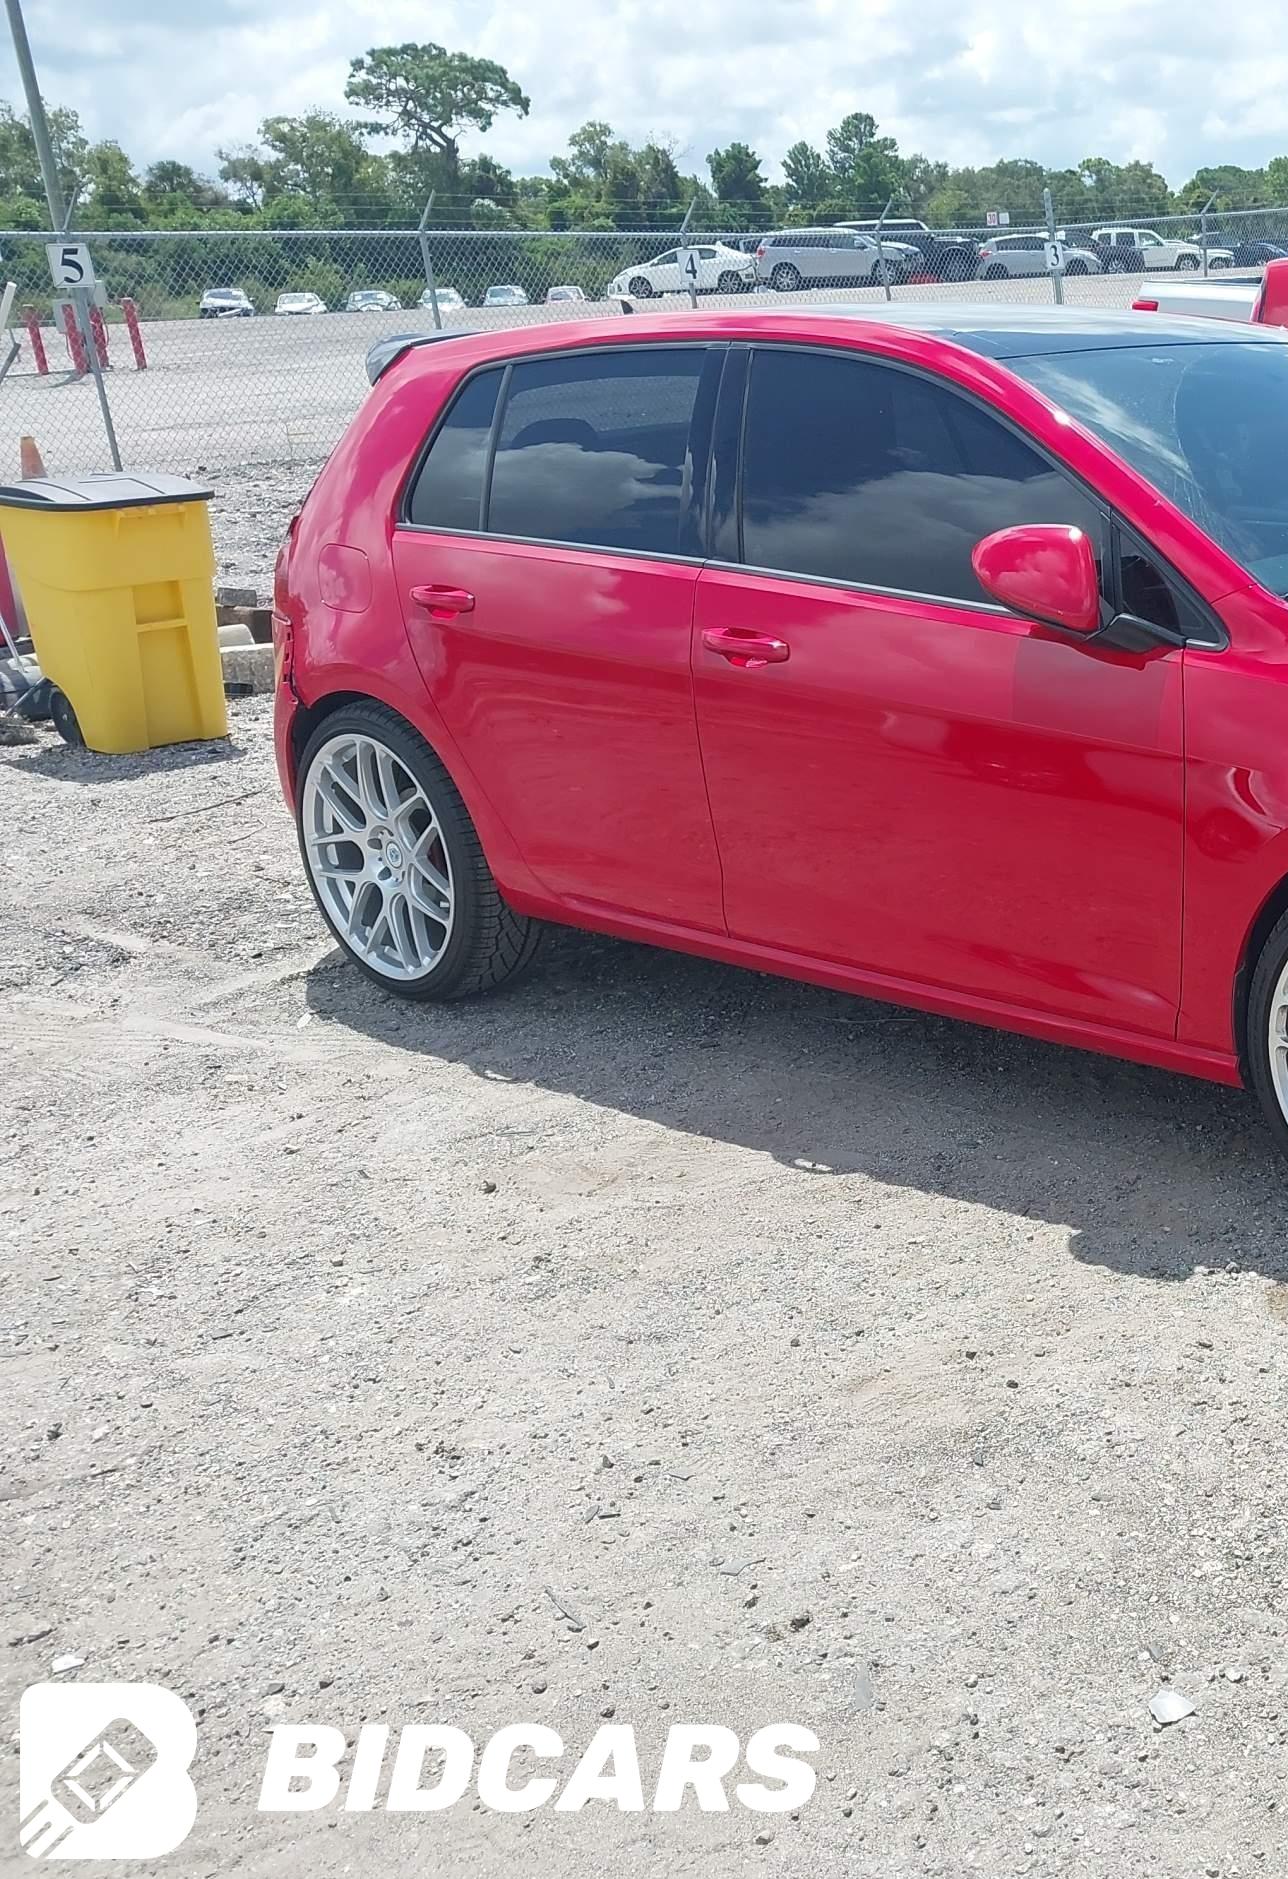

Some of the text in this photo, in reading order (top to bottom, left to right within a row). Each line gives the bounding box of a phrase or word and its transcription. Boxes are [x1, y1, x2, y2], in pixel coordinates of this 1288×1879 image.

[61, 247, 84, 284] 5
[685, 253, 698, 280] 4
[1050, 244, 1060, 267] 3
